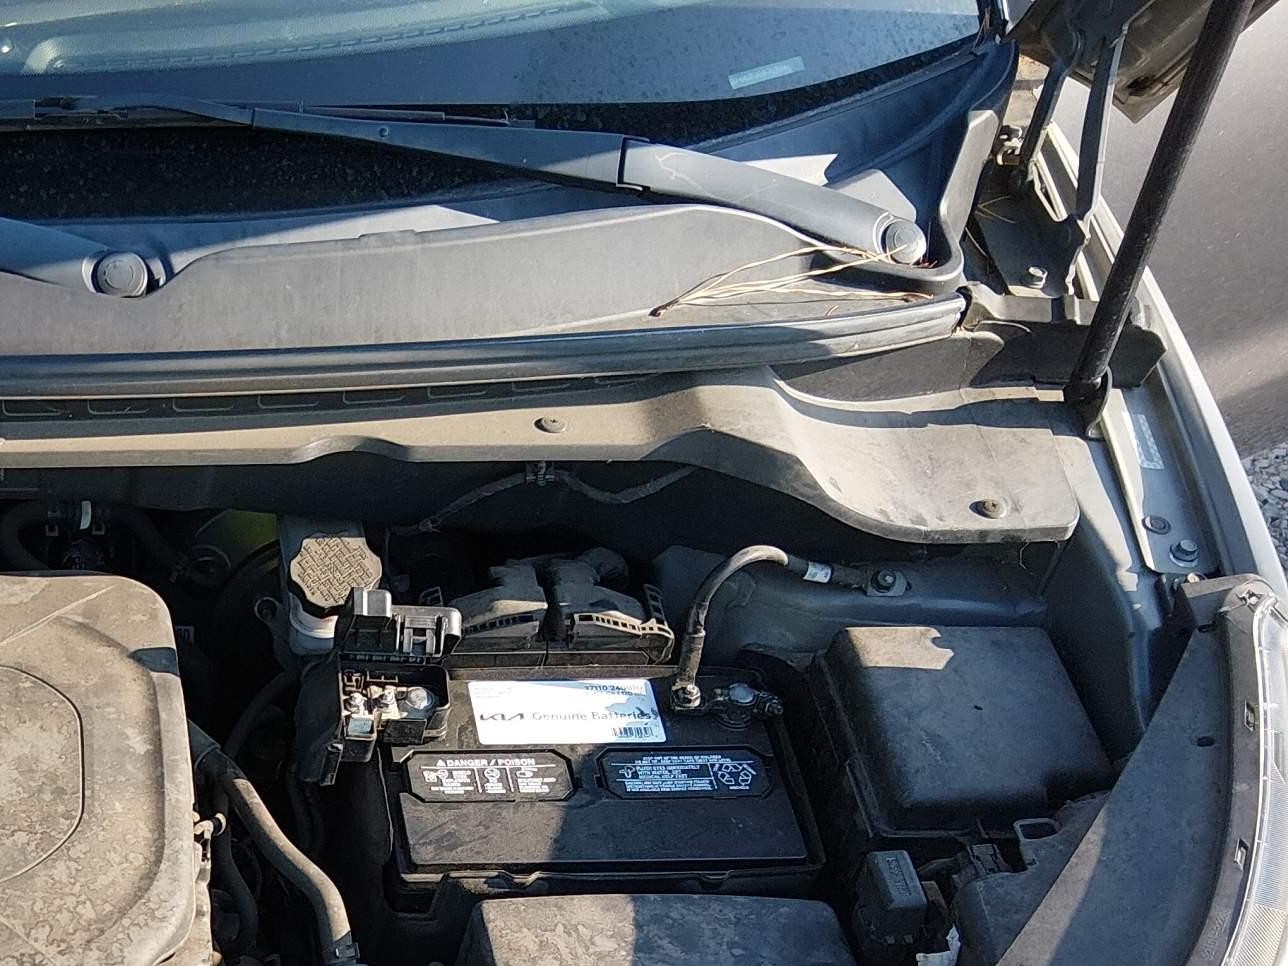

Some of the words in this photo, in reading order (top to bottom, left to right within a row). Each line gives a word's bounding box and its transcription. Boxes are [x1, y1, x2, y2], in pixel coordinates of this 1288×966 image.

[532, 711, 588, 721] Genuine
[592, 711, 652, 721] Batteries
[498, 758, 536, 766] POISON
